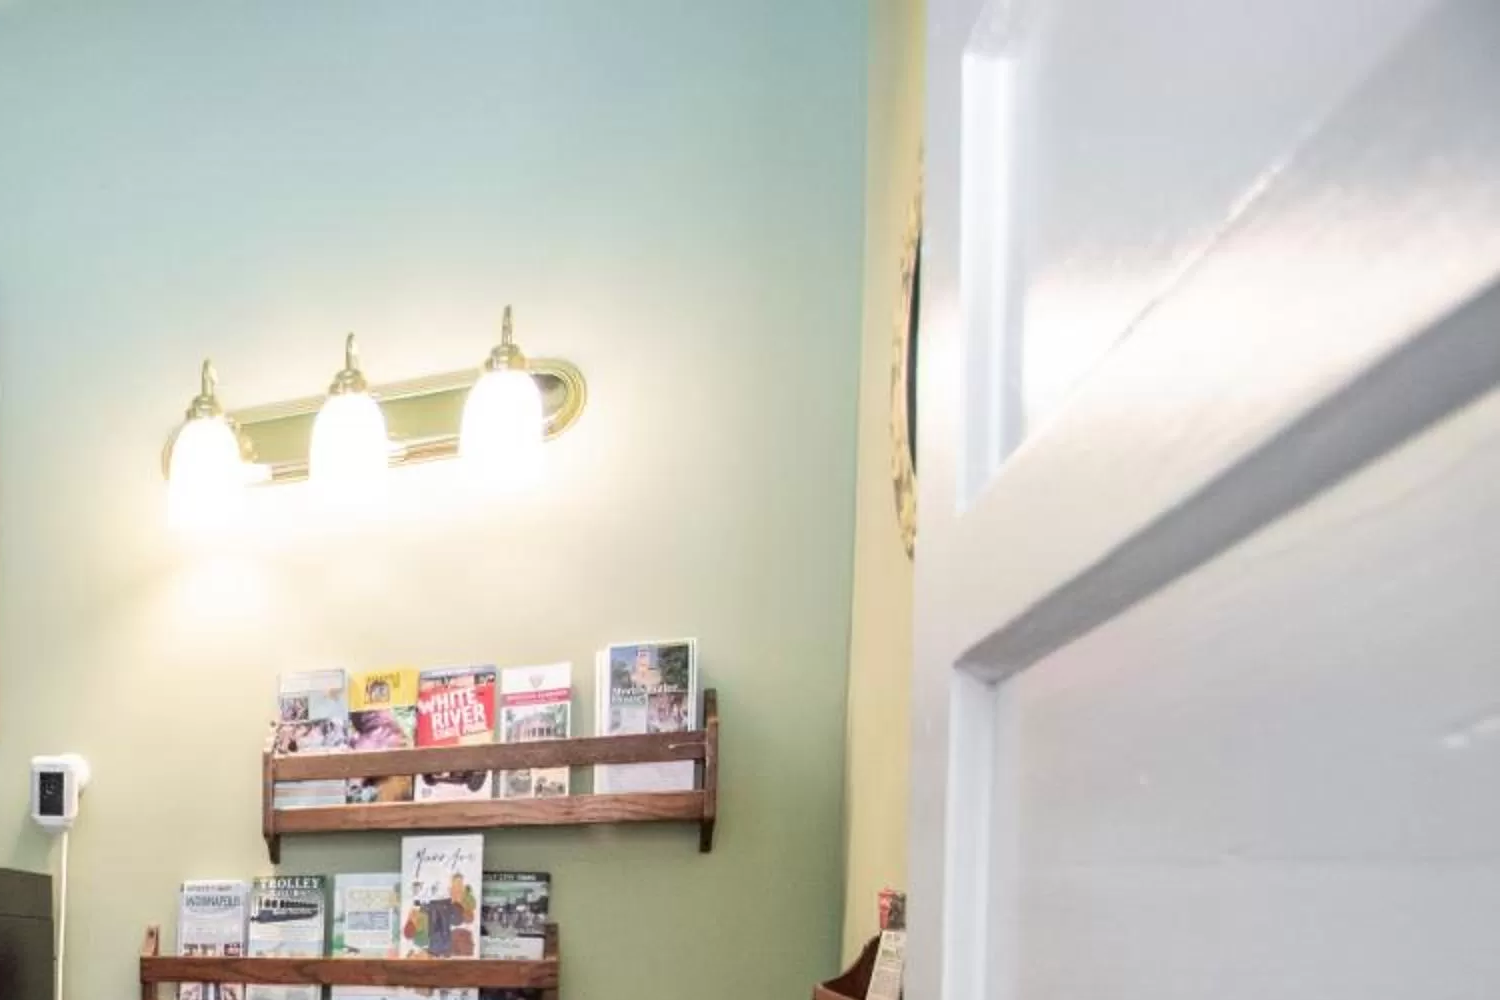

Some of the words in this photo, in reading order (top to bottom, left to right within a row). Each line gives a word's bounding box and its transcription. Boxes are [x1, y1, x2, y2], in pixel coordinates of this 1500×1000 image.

[417, 687, 478, 714] WHITE
[431, 704, 486, 729] RIVER
[259, 877, 318, 889] TROLLEY
